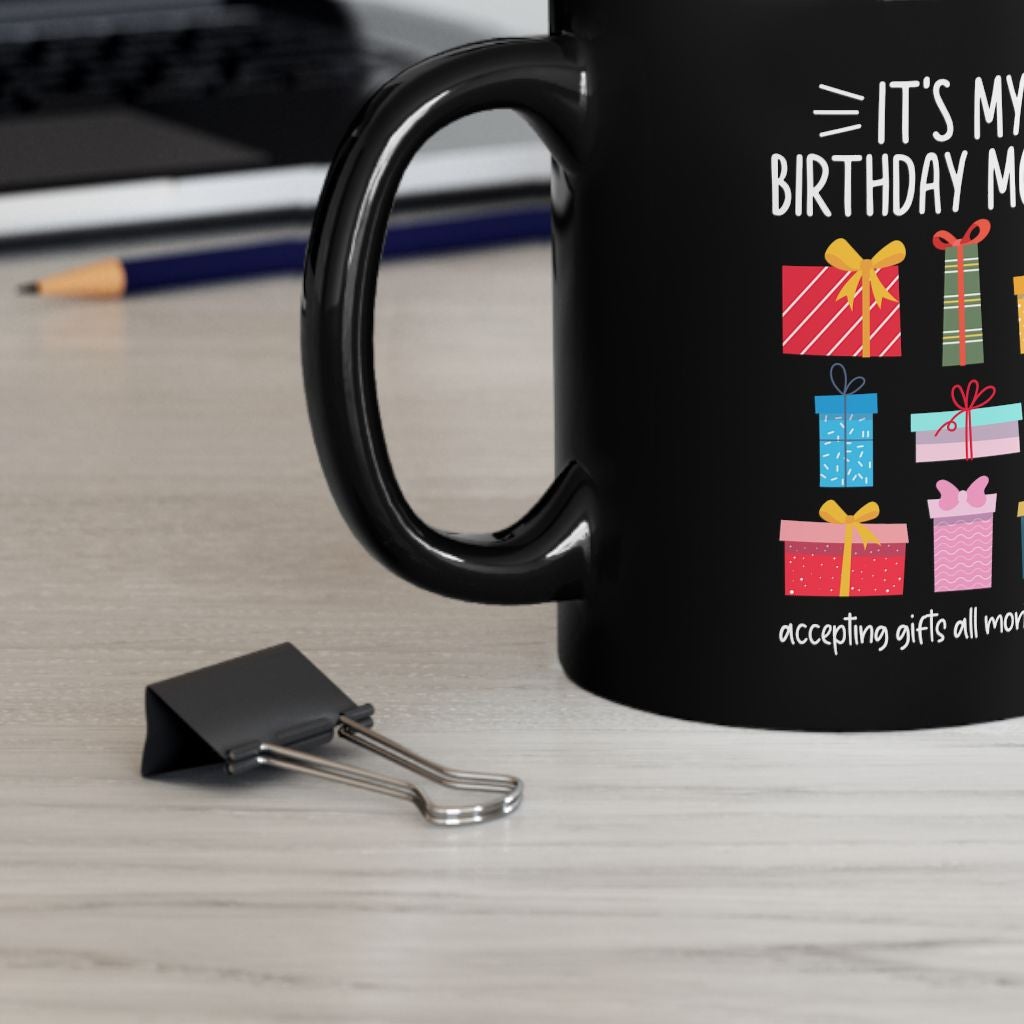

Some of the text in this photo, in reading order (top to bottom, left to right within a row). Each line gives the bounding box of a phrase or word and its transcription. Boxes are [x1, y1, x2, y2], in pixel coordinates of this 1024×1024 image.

[877, 75, 955, 145] IT'S
[770, 149, 969, 218] BIRTHDAY
[778, 611, 889, 656] accepting
[895, 608, 947, 651] gifts
[953, 606, 979, 640] all
